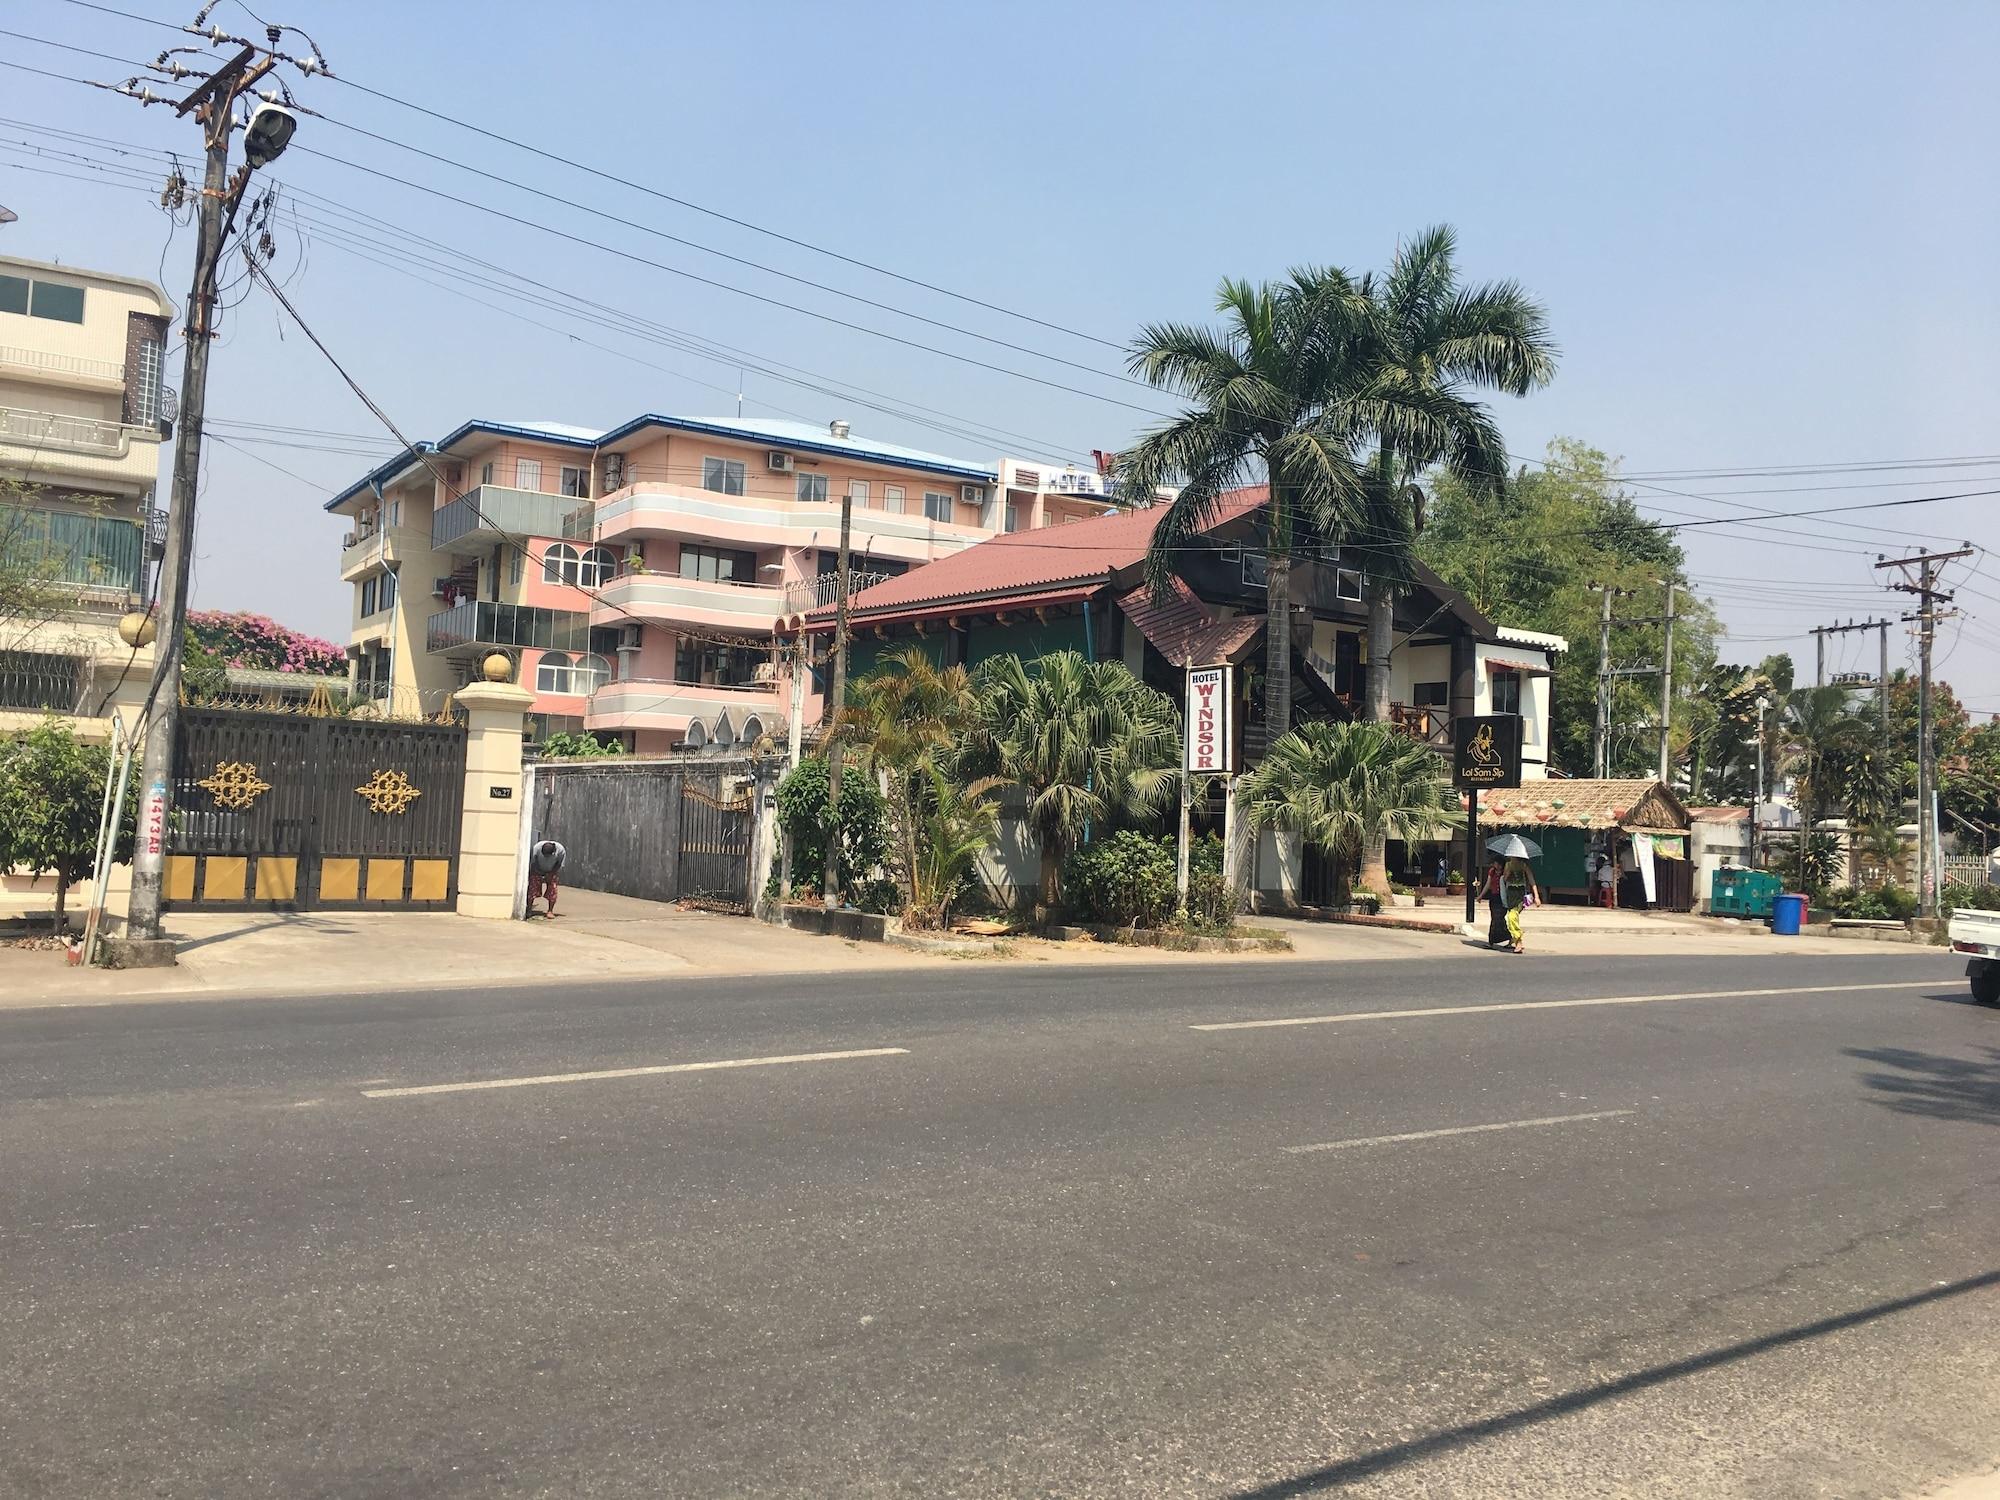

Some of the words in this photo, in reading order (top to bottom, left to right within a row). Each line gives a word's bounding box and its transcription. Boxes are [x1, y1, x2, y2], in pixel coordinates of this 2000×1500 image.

[1192, 673, 1220, 684] HOTEL
[1194, 684, 1217, 769] WINDSOR
[1474, 767, 1491, 777] Sam
